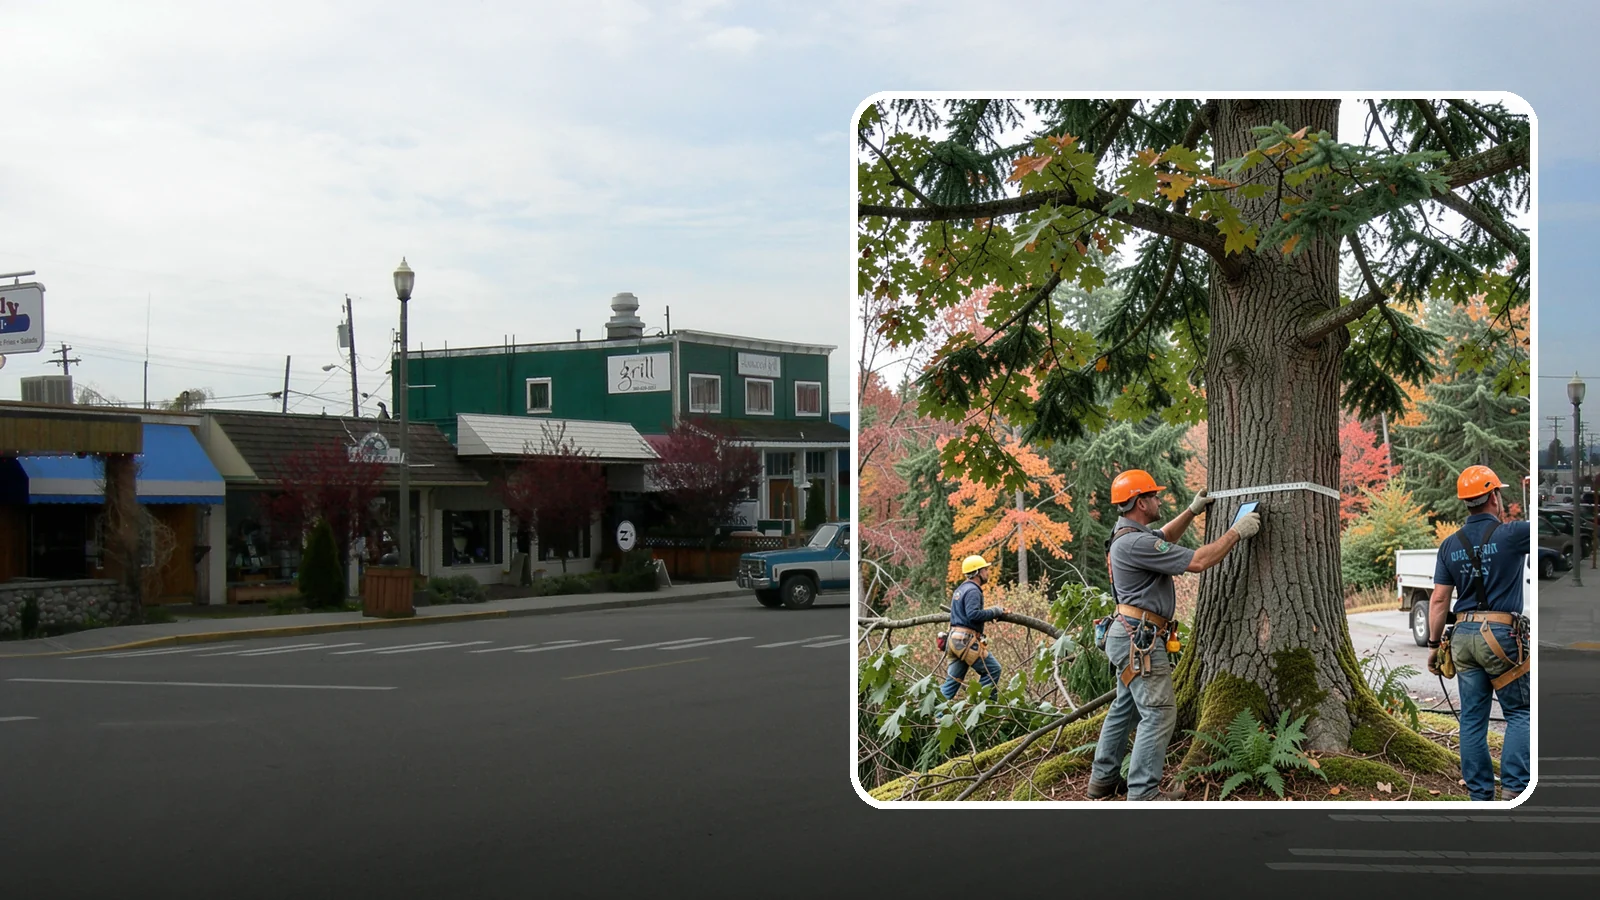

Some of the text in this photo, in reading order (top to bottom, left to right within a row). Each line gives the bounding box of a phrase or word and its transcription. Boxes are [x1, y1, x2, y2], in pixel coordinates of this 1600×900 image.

[3, 336, 38, 346] Fries Salads
[618, 356, 655, 391] grill
